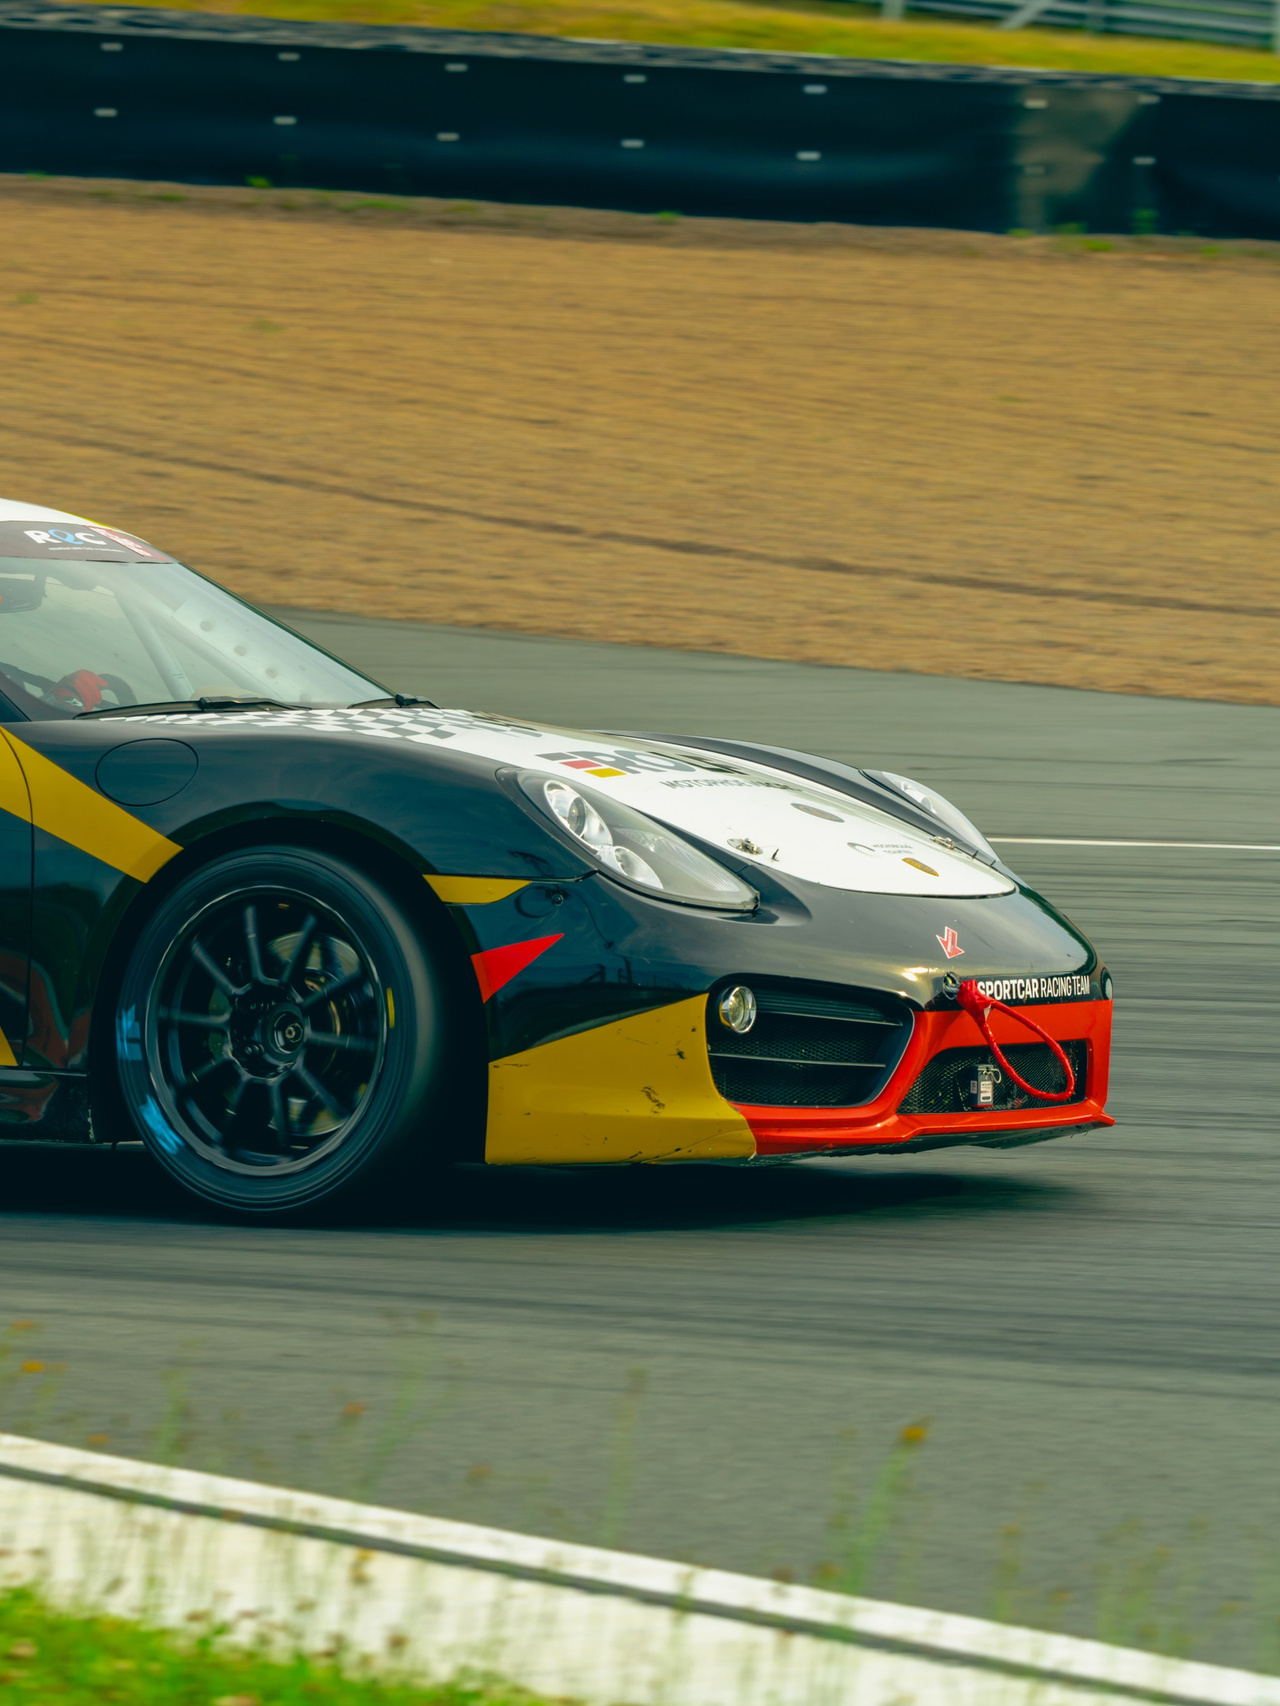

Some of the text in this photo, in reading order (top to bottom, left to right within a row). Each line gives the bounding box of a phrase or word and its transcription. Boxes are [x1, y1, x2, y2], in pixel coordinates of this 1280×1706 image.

[977, 974, 1091, 1000] SPORTCAR RACING TEAM
